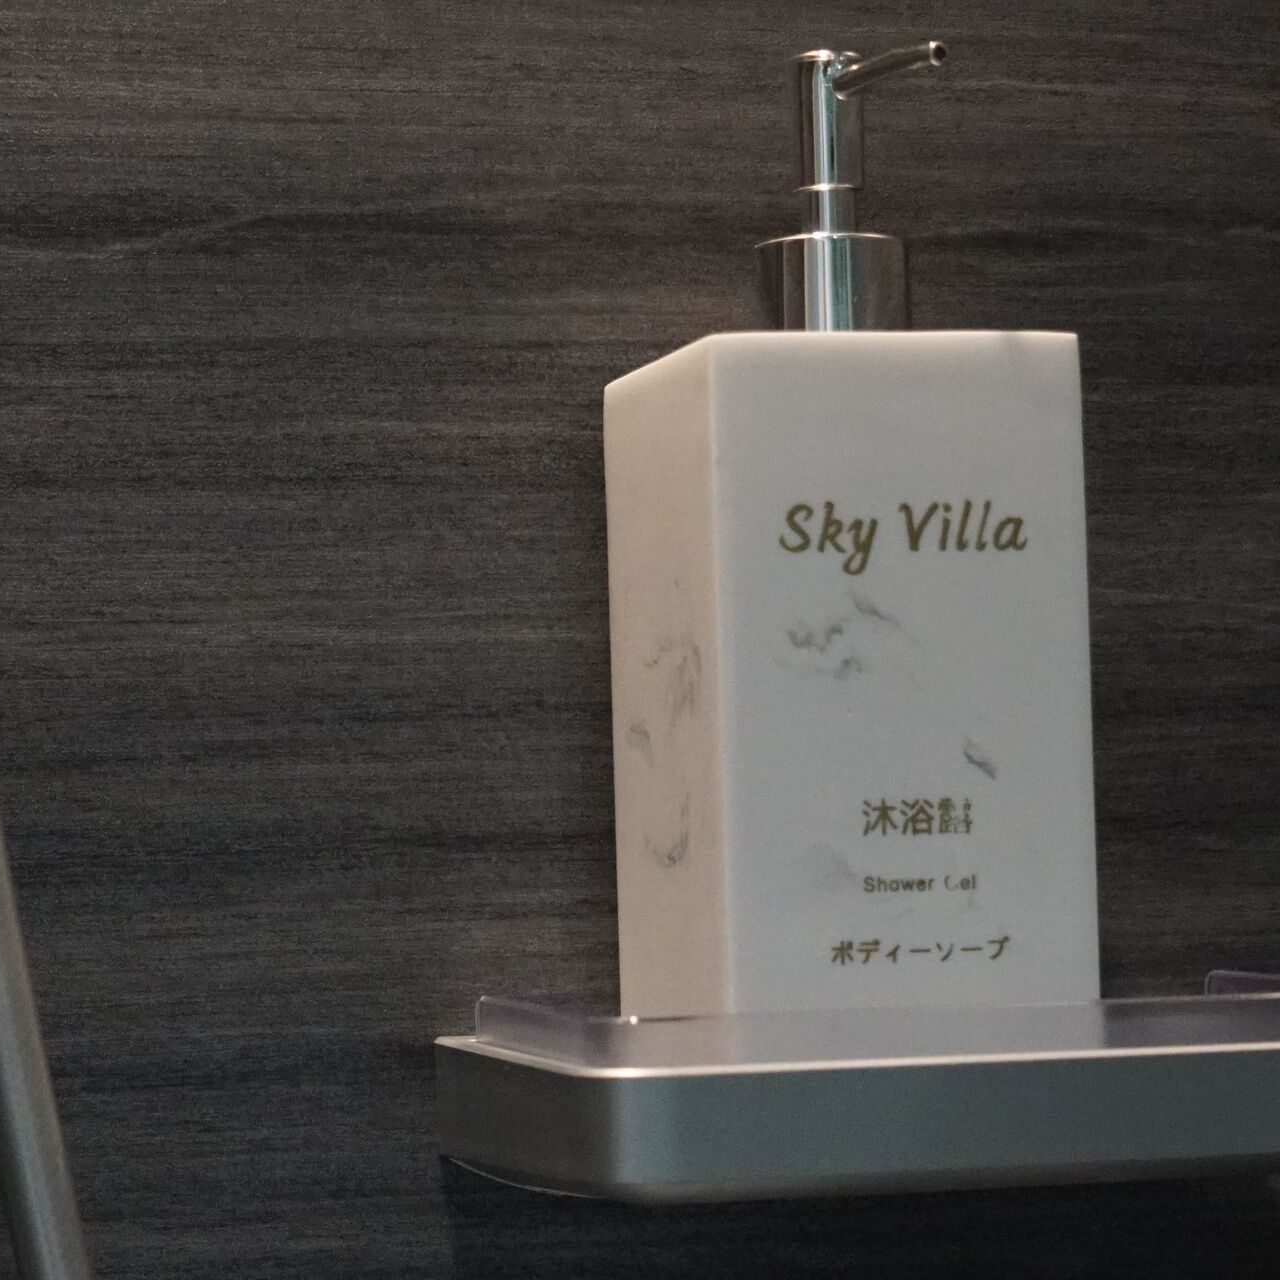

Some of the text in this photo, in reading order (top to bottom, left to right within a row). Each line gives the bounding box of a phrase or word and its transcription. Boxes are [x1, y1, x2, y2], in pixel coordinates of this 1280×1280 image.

[779, 499, 1028, 576] Sky Villa
[862, 876, 935, 893] Shower
[831, 934, 1010, 966] ボディーソープ
